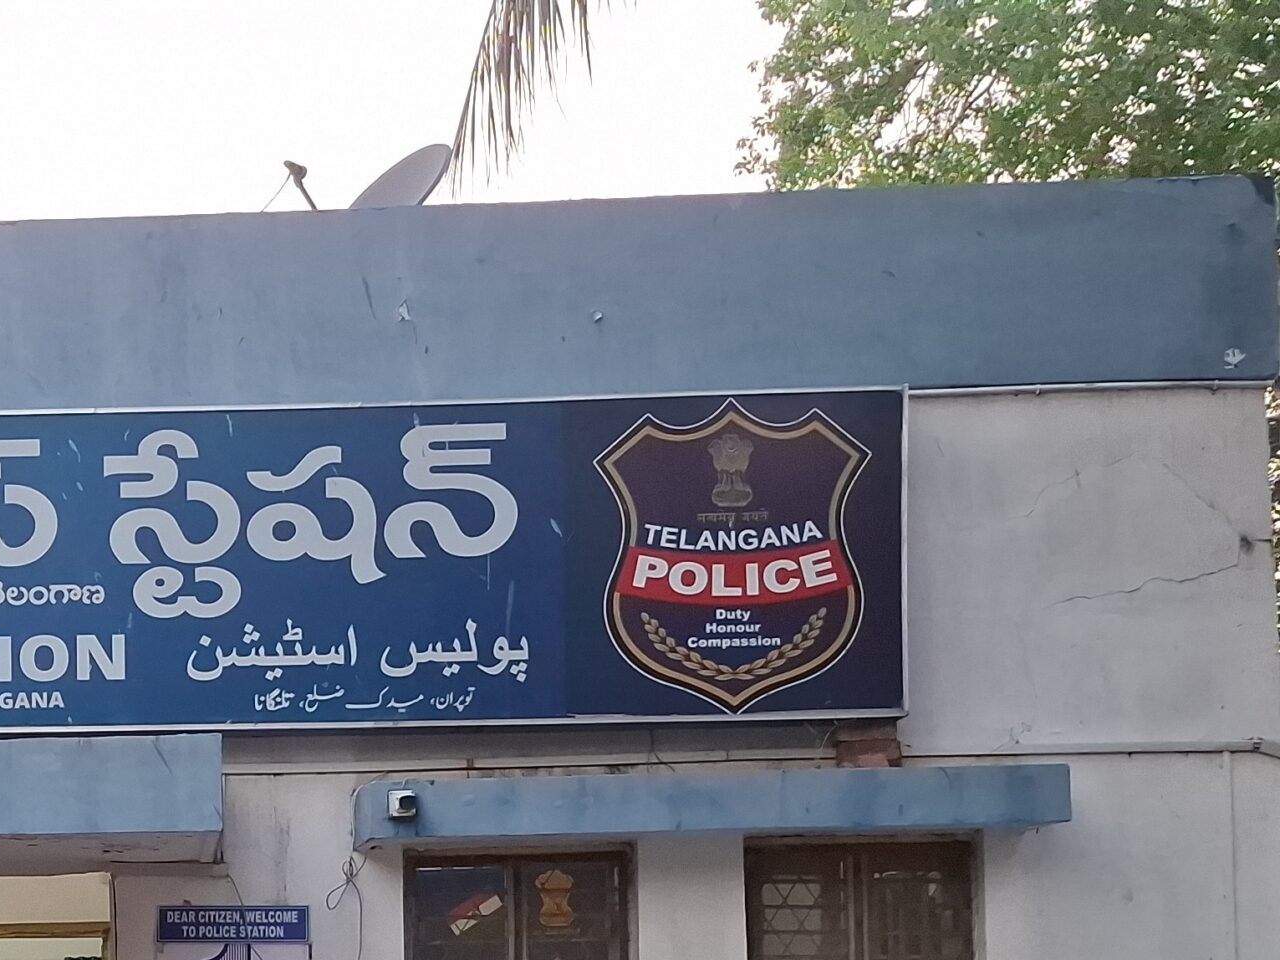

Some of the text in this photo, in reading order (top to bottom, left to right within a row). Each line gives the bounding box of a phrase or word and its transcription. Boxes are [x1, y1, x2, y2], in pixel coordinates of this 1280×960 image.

[103, 422, 519, 619] స్టేషన్
[643, 519, 824, 551] TELANGANA
[631, 548, 838, 598] POLICE
[715, 608, 751, 622] Duty
[704, 622, 762, 634] Honour
[686, 634, 781, 650] Compassion
[186, 618, 530, 683] پولیس اسٹیشن
[166, 910, 299, 925] DEAR CITIZEN, WELCOME
[181, 925, 285, 938] TO POLICE STATION
